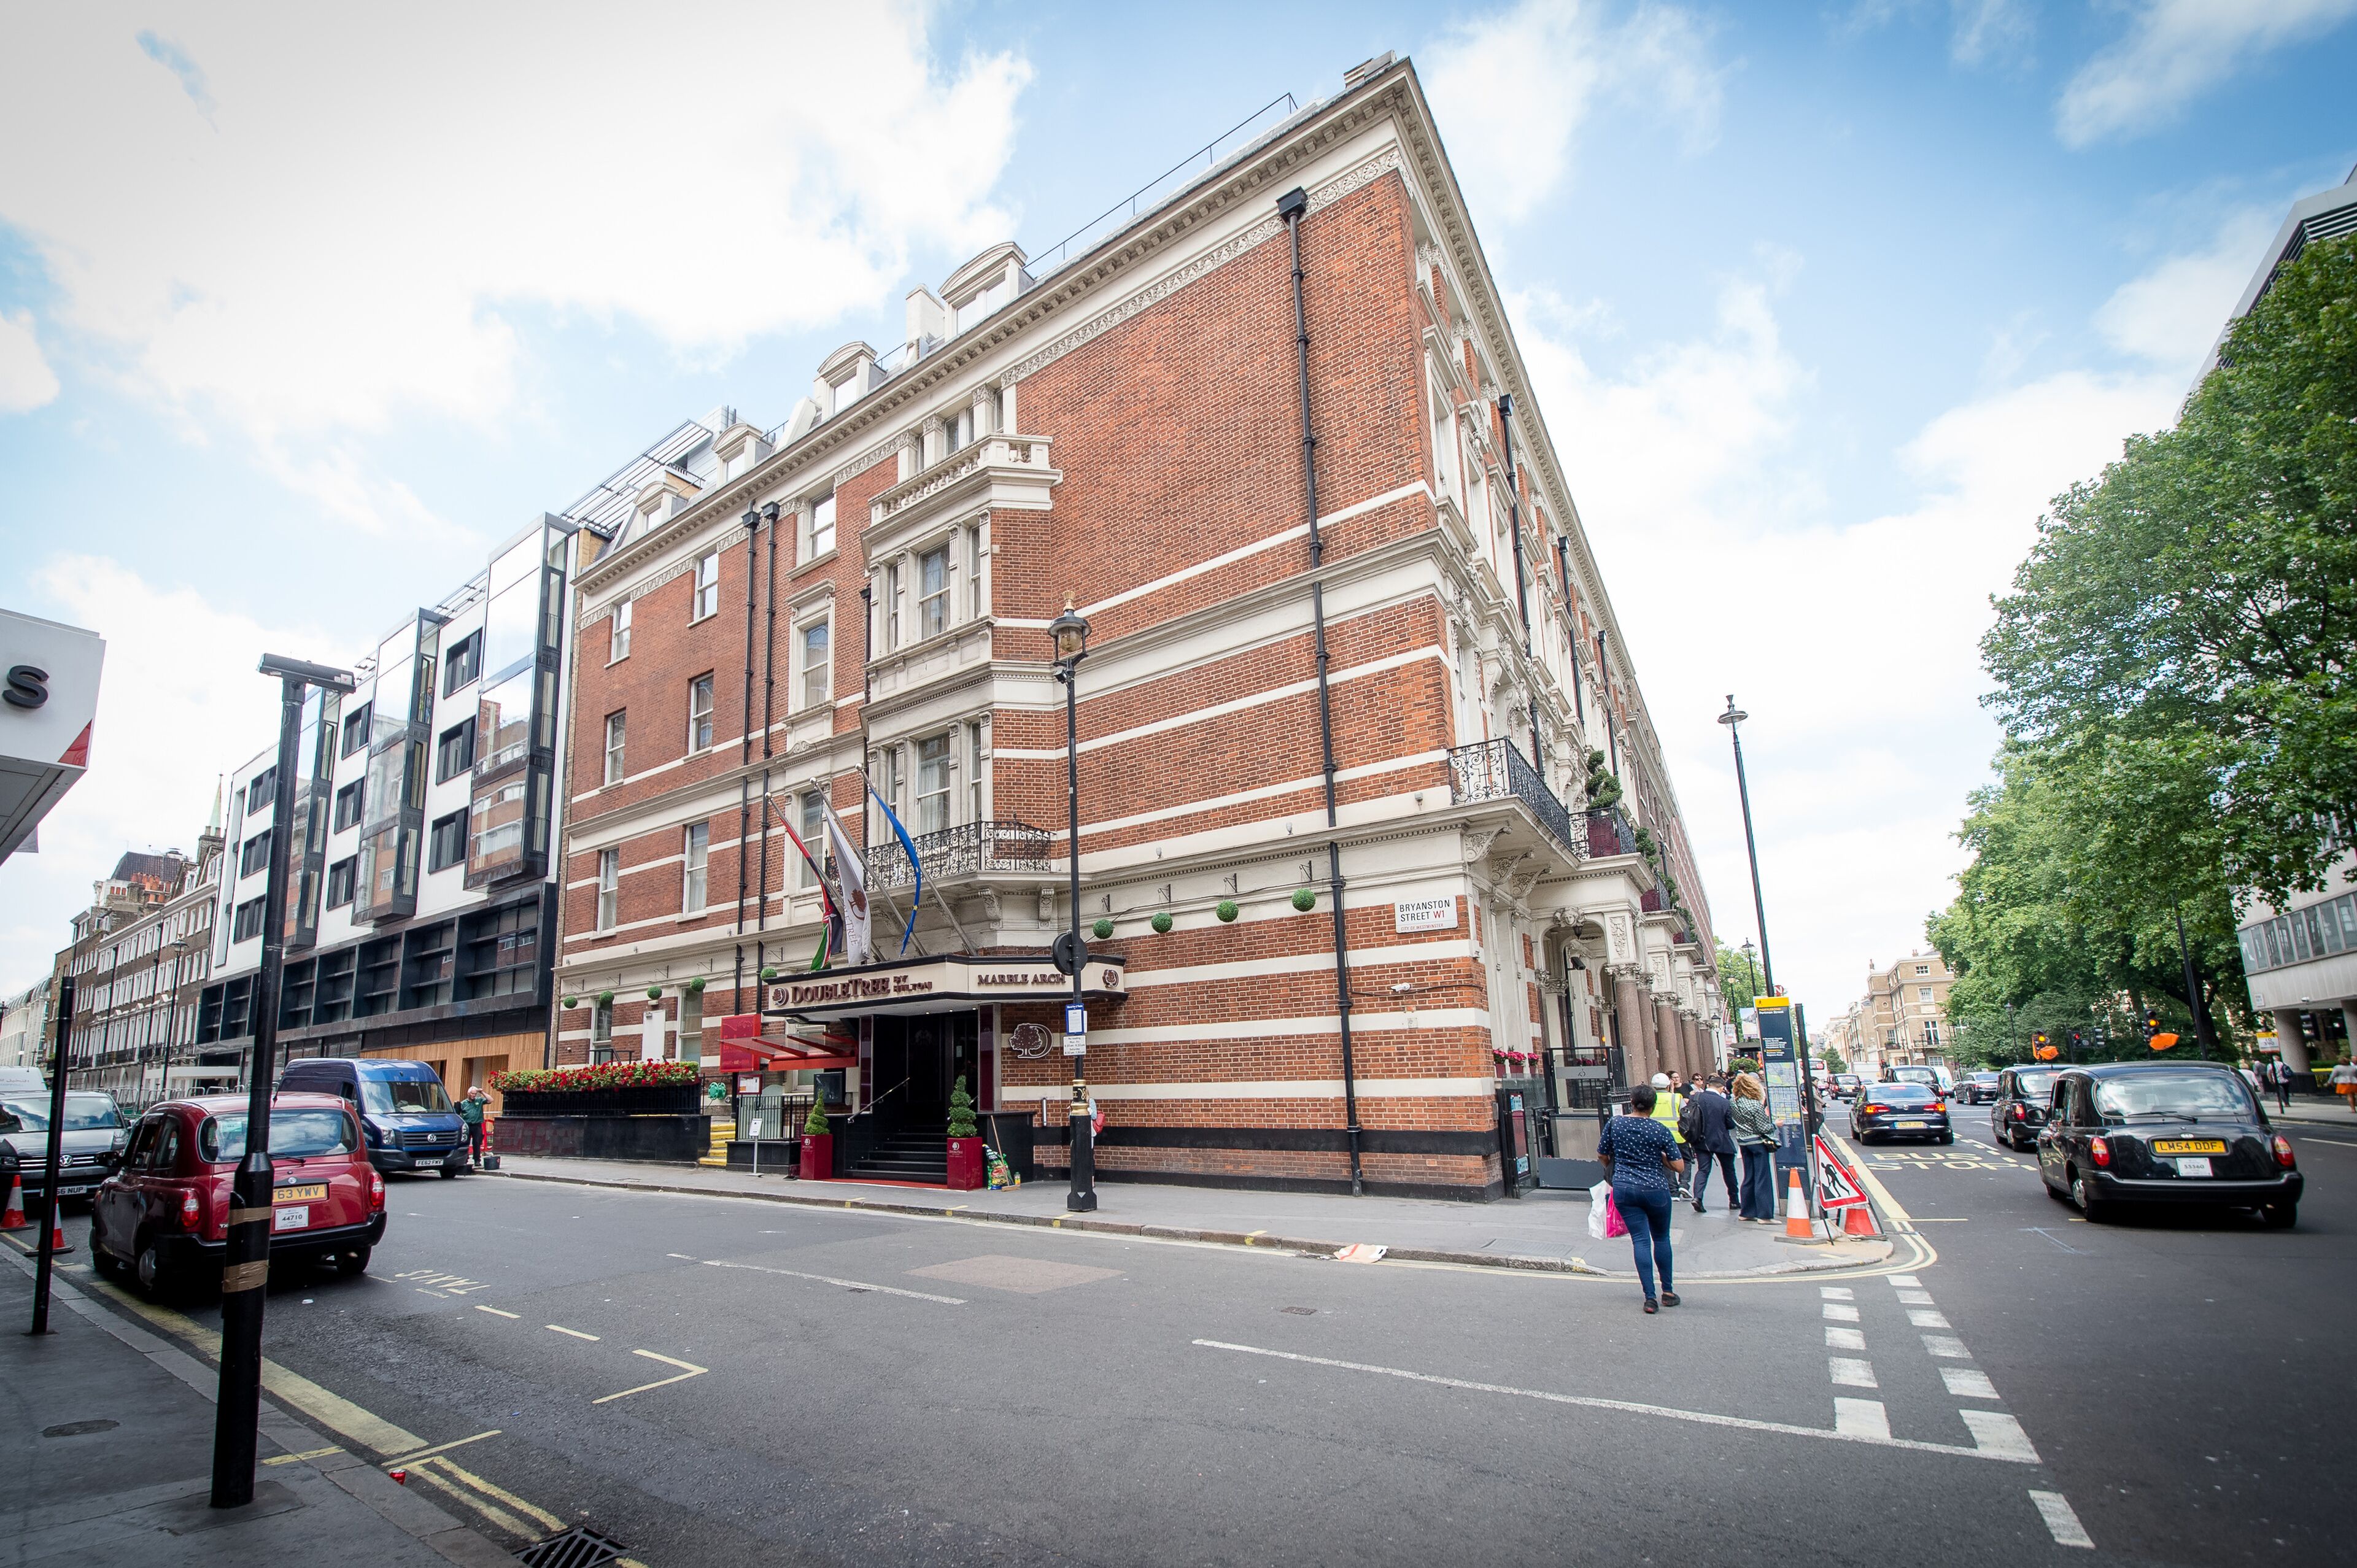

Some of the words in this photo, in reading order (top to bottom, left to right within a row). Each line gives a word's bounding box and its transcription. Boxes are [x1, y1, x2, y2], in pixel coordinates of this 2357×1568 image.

[1399, 899, 1450, 912] BRYANSTON
[1401, 911, 1430, 922] STREET
[1433, 910, 1444, 919] W1
[978, 973, 1029, 985] MARBLE
[1031, 973, 1066, 984] ARCH
[893, 981, 932, 992] HILTON
[2160, 1142, 2191, 1151] LM54
[2194, 1142, 2217, 1151] DDF
[1872, 1153, 1983, 1161] BUS
[1866, 1161, 2019, 1170] STOP
[274, 1189, 293, 1199] 63
[296, 1186, 319, 1197] YWV
[395, 1269, 490, 1294] TAXIS
